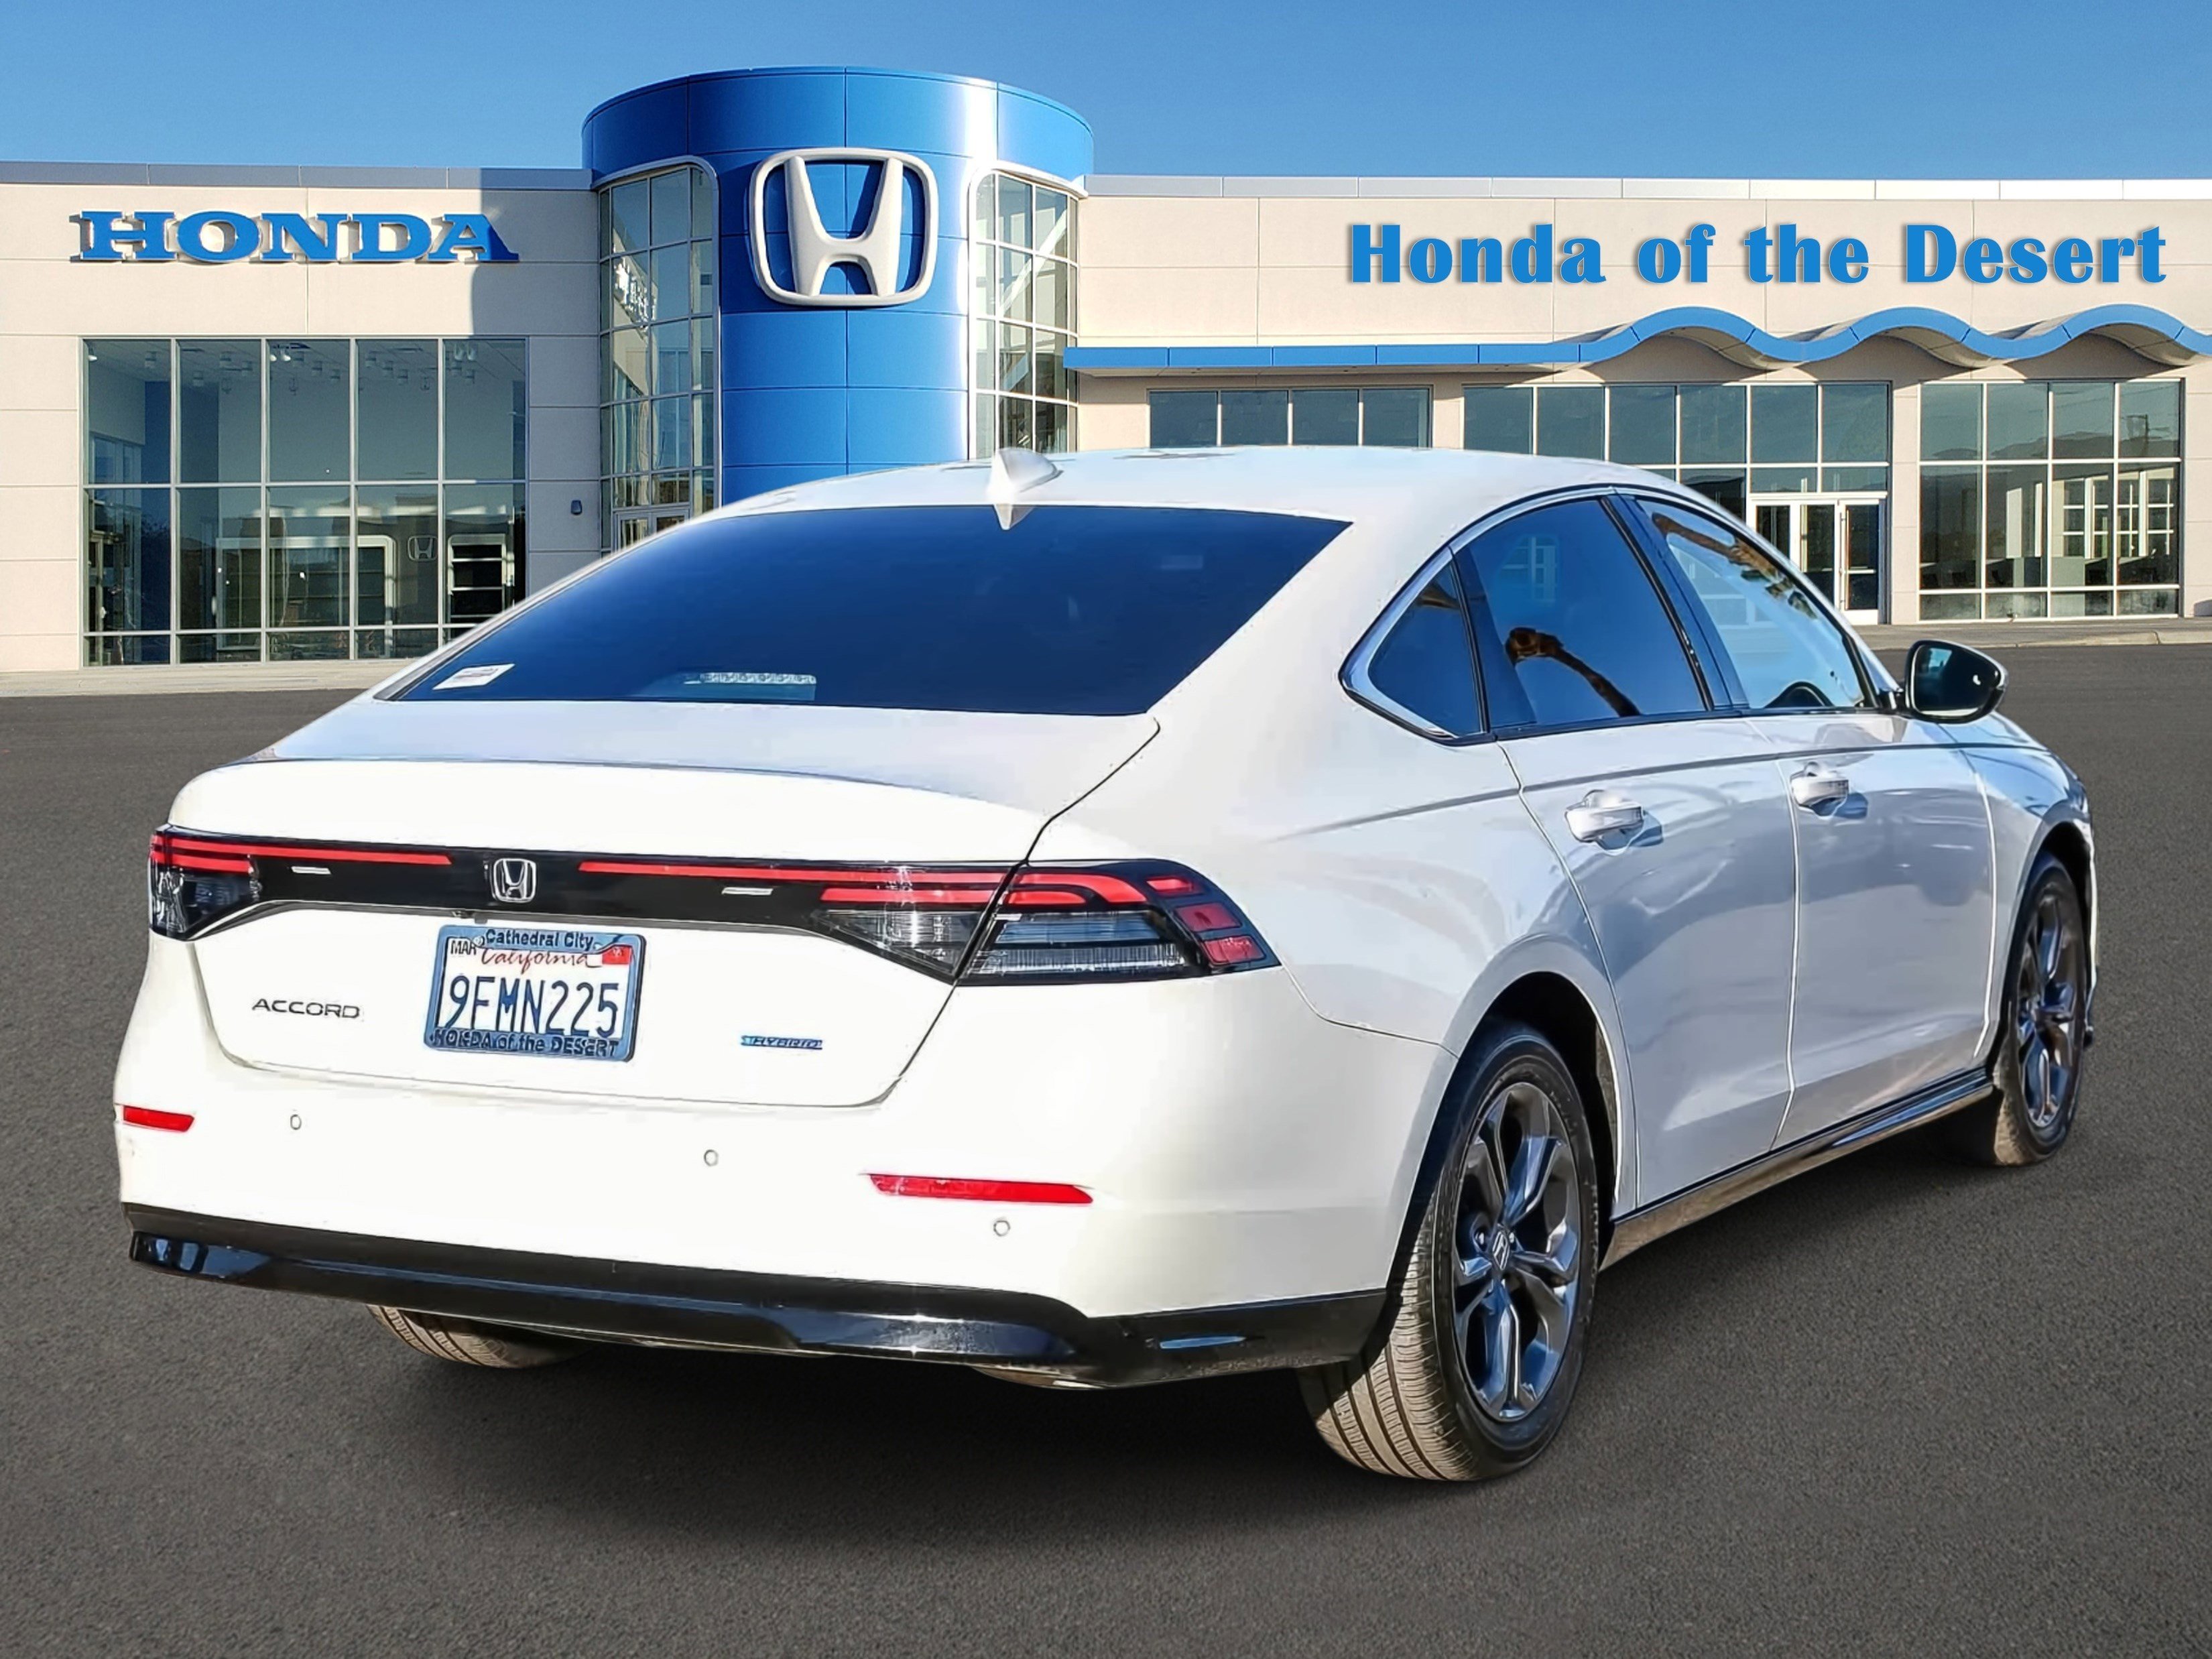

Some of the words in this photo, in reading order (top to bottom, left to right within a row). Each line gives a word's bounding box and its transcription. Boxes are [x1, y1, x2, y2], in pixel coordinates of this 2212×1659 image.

[79, 210, 519, 262] HONDA
[1351, 223, 1607, 284] Honda
[1638, 223, 1717, 284] of
[1743, 223, 1869, 284] the
[1905, 224, 2167, 284] Desert
[486, 928, 559, 947] Cathedral
[564, 932, 594, 951] City
[481, 948, 603, 974] California
[251, 998, 360, 1018] ACCORD
[497, 1034, 514, 1049] of
[519, 1035, 545, 1052] the
[551, 1036, 619, 1057] DESERT
